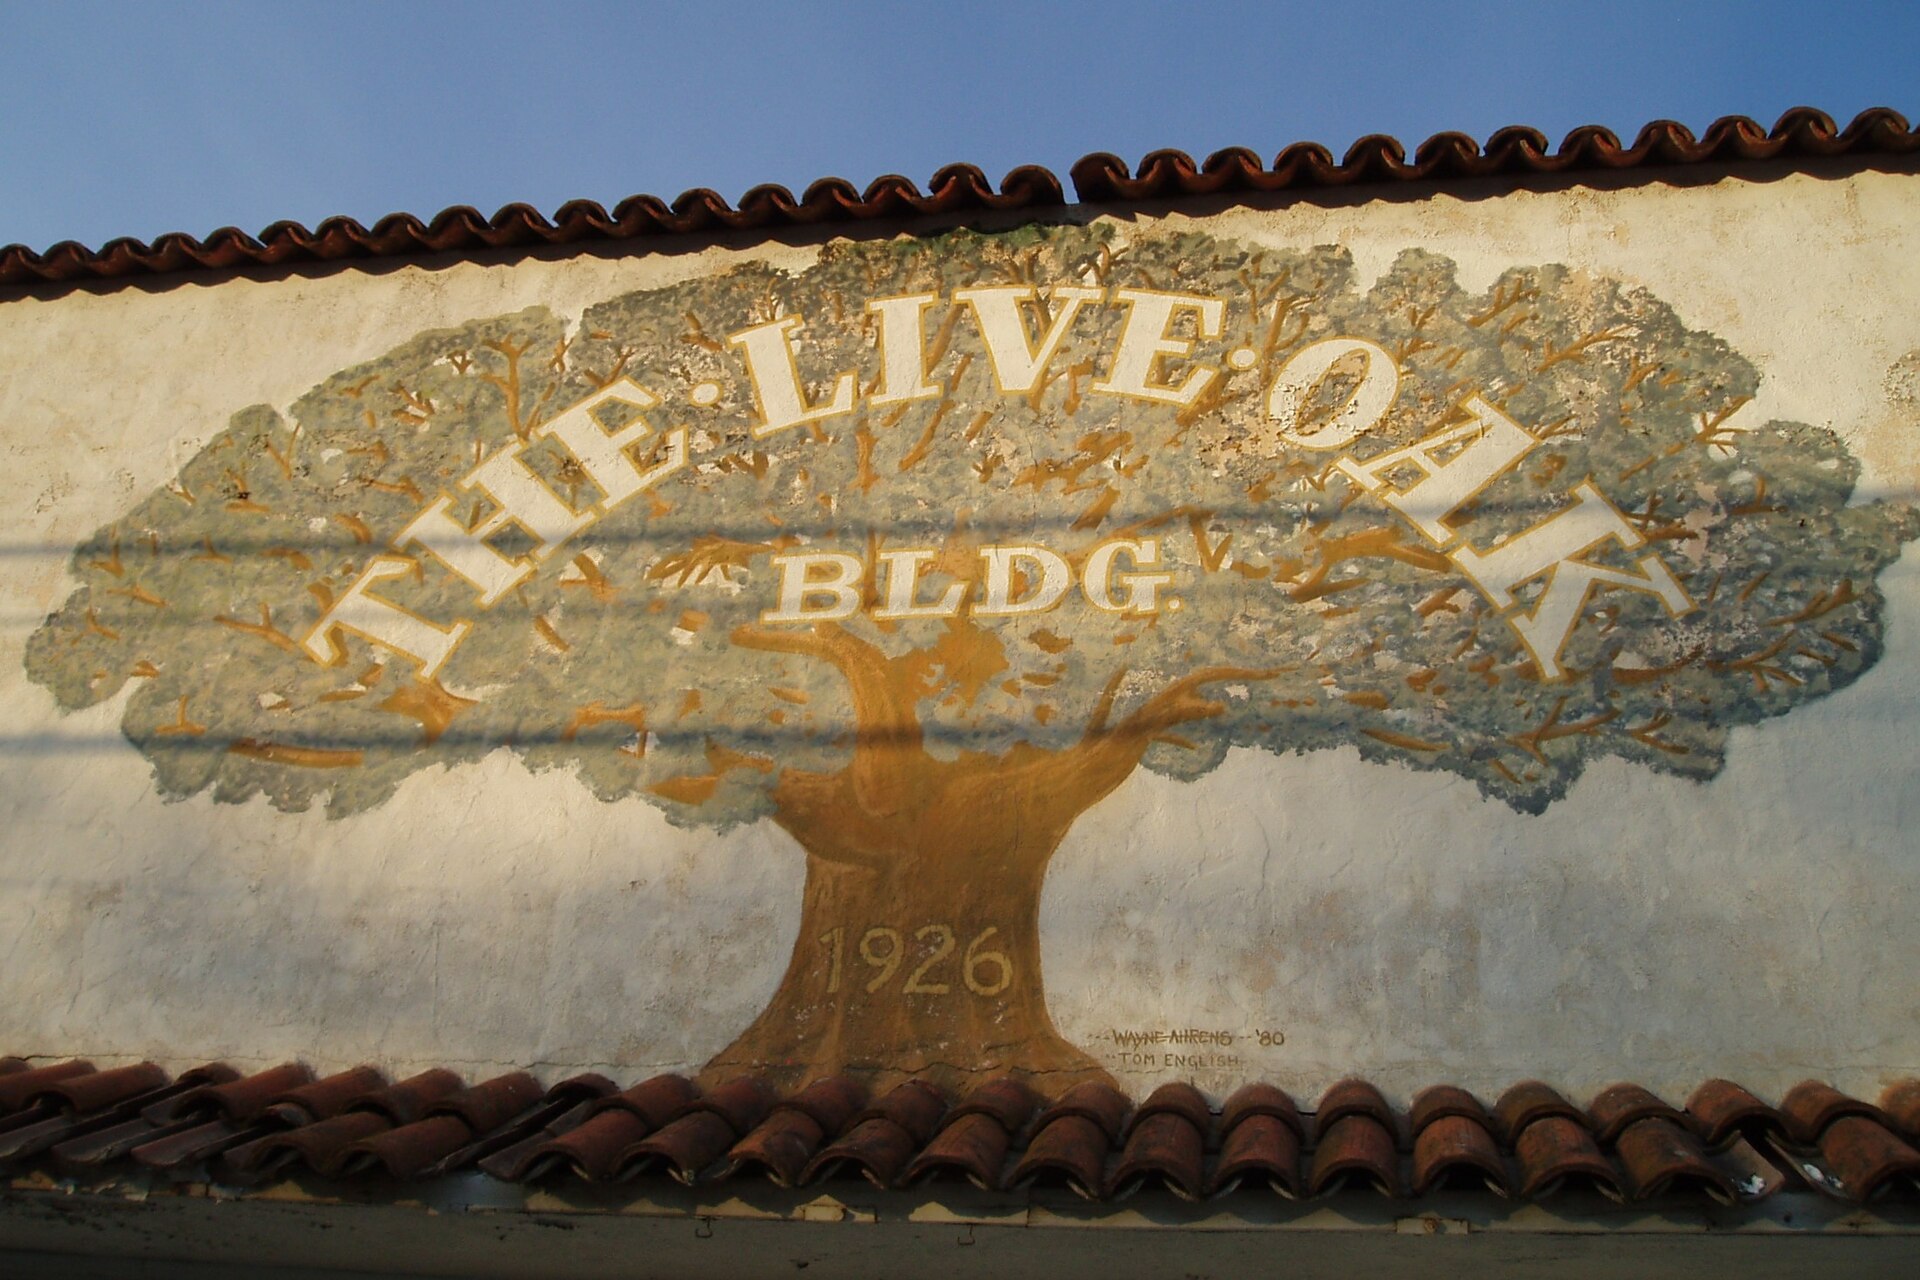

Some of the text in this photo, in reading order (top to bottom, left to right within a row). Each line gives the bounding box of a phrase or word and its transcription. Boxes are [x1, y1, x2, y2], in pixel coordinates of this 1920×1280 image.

[299, 285, 1698, 683] THE LIVE OAK
[760, 538, 1184, 624] BLDG.
[819, 924, 1013, 996] 1926
[1118, 1052, 1240, 1070] TOM ENGLISH
[1256, 1029, 1285, 1046] '80
